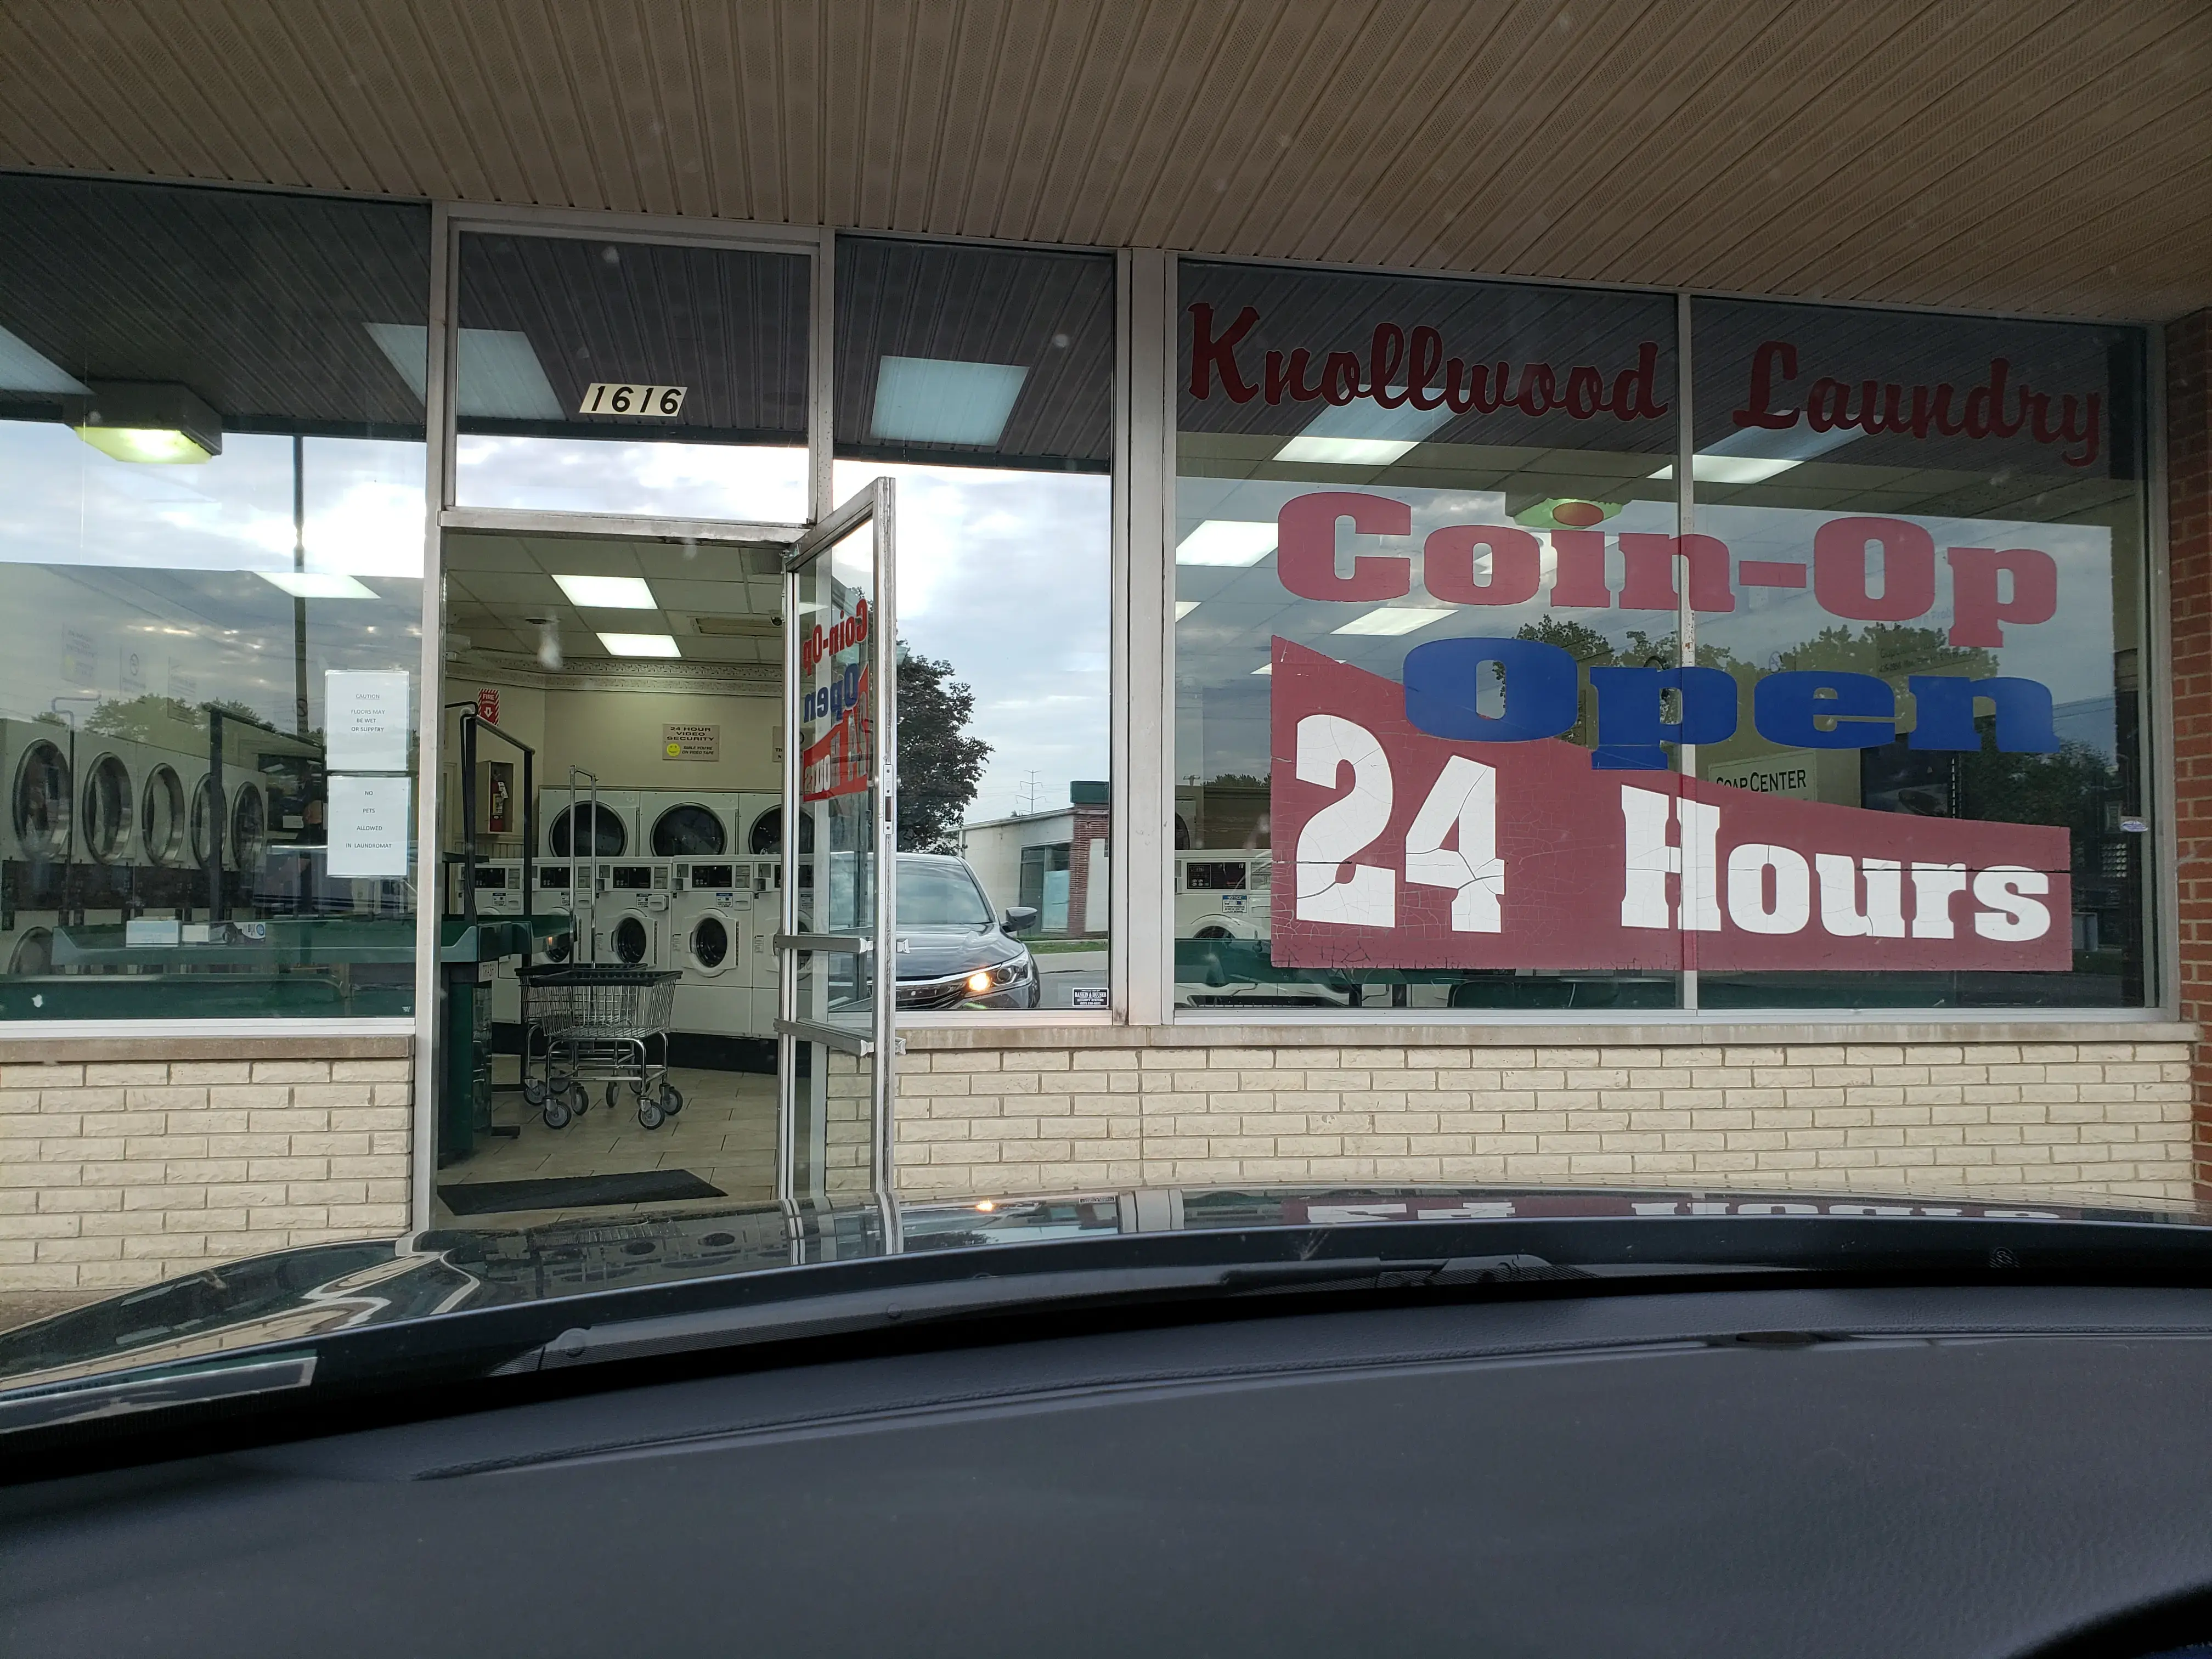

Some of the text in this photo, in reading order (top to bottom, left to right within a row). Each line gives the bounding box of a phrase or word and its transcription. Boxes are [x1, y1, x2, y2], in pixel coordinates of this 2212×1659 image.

[591, 386, 682, 414] 1616
[1187, 302, 2101, 467] Knollwood Laundry
[1278, 492, 2057, 648] Coin-Op
[1403, 637, 2061, 770] Open
[1296, 714, 2052, 941] 24 Hours
[1750, 769, 1806, 792] CENTER
